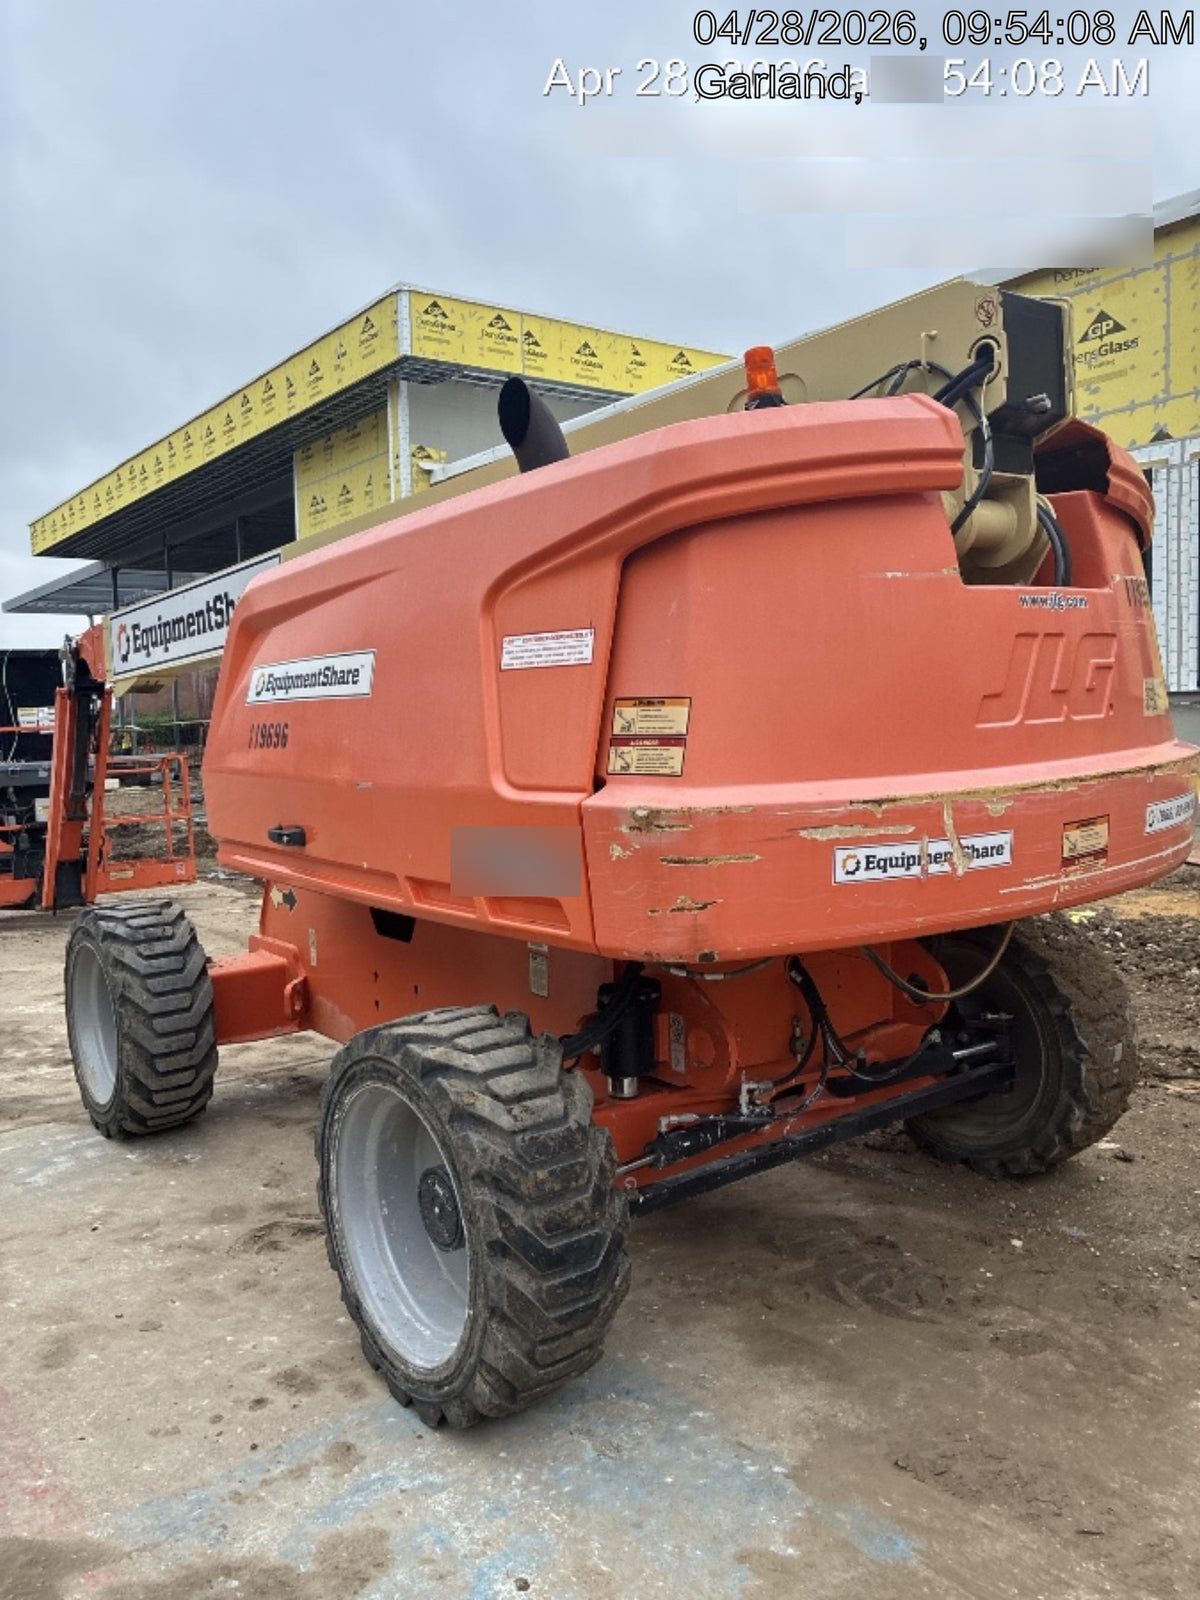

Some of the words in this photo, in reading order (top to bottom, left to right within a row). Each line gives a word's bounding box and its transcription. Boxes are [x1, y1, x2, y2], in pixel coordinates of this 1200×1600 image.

[1088, 319, 1114, 338] GP
[1075, 337, 1140, 364] ensGlass
[1019, 592, 1088, 611] www.jlg.com
[130, 591, 236, 659] EquipmentSh
[265, 665, 360, 696] EquipmentShare
[975, 632, 1117, 728] JLG
